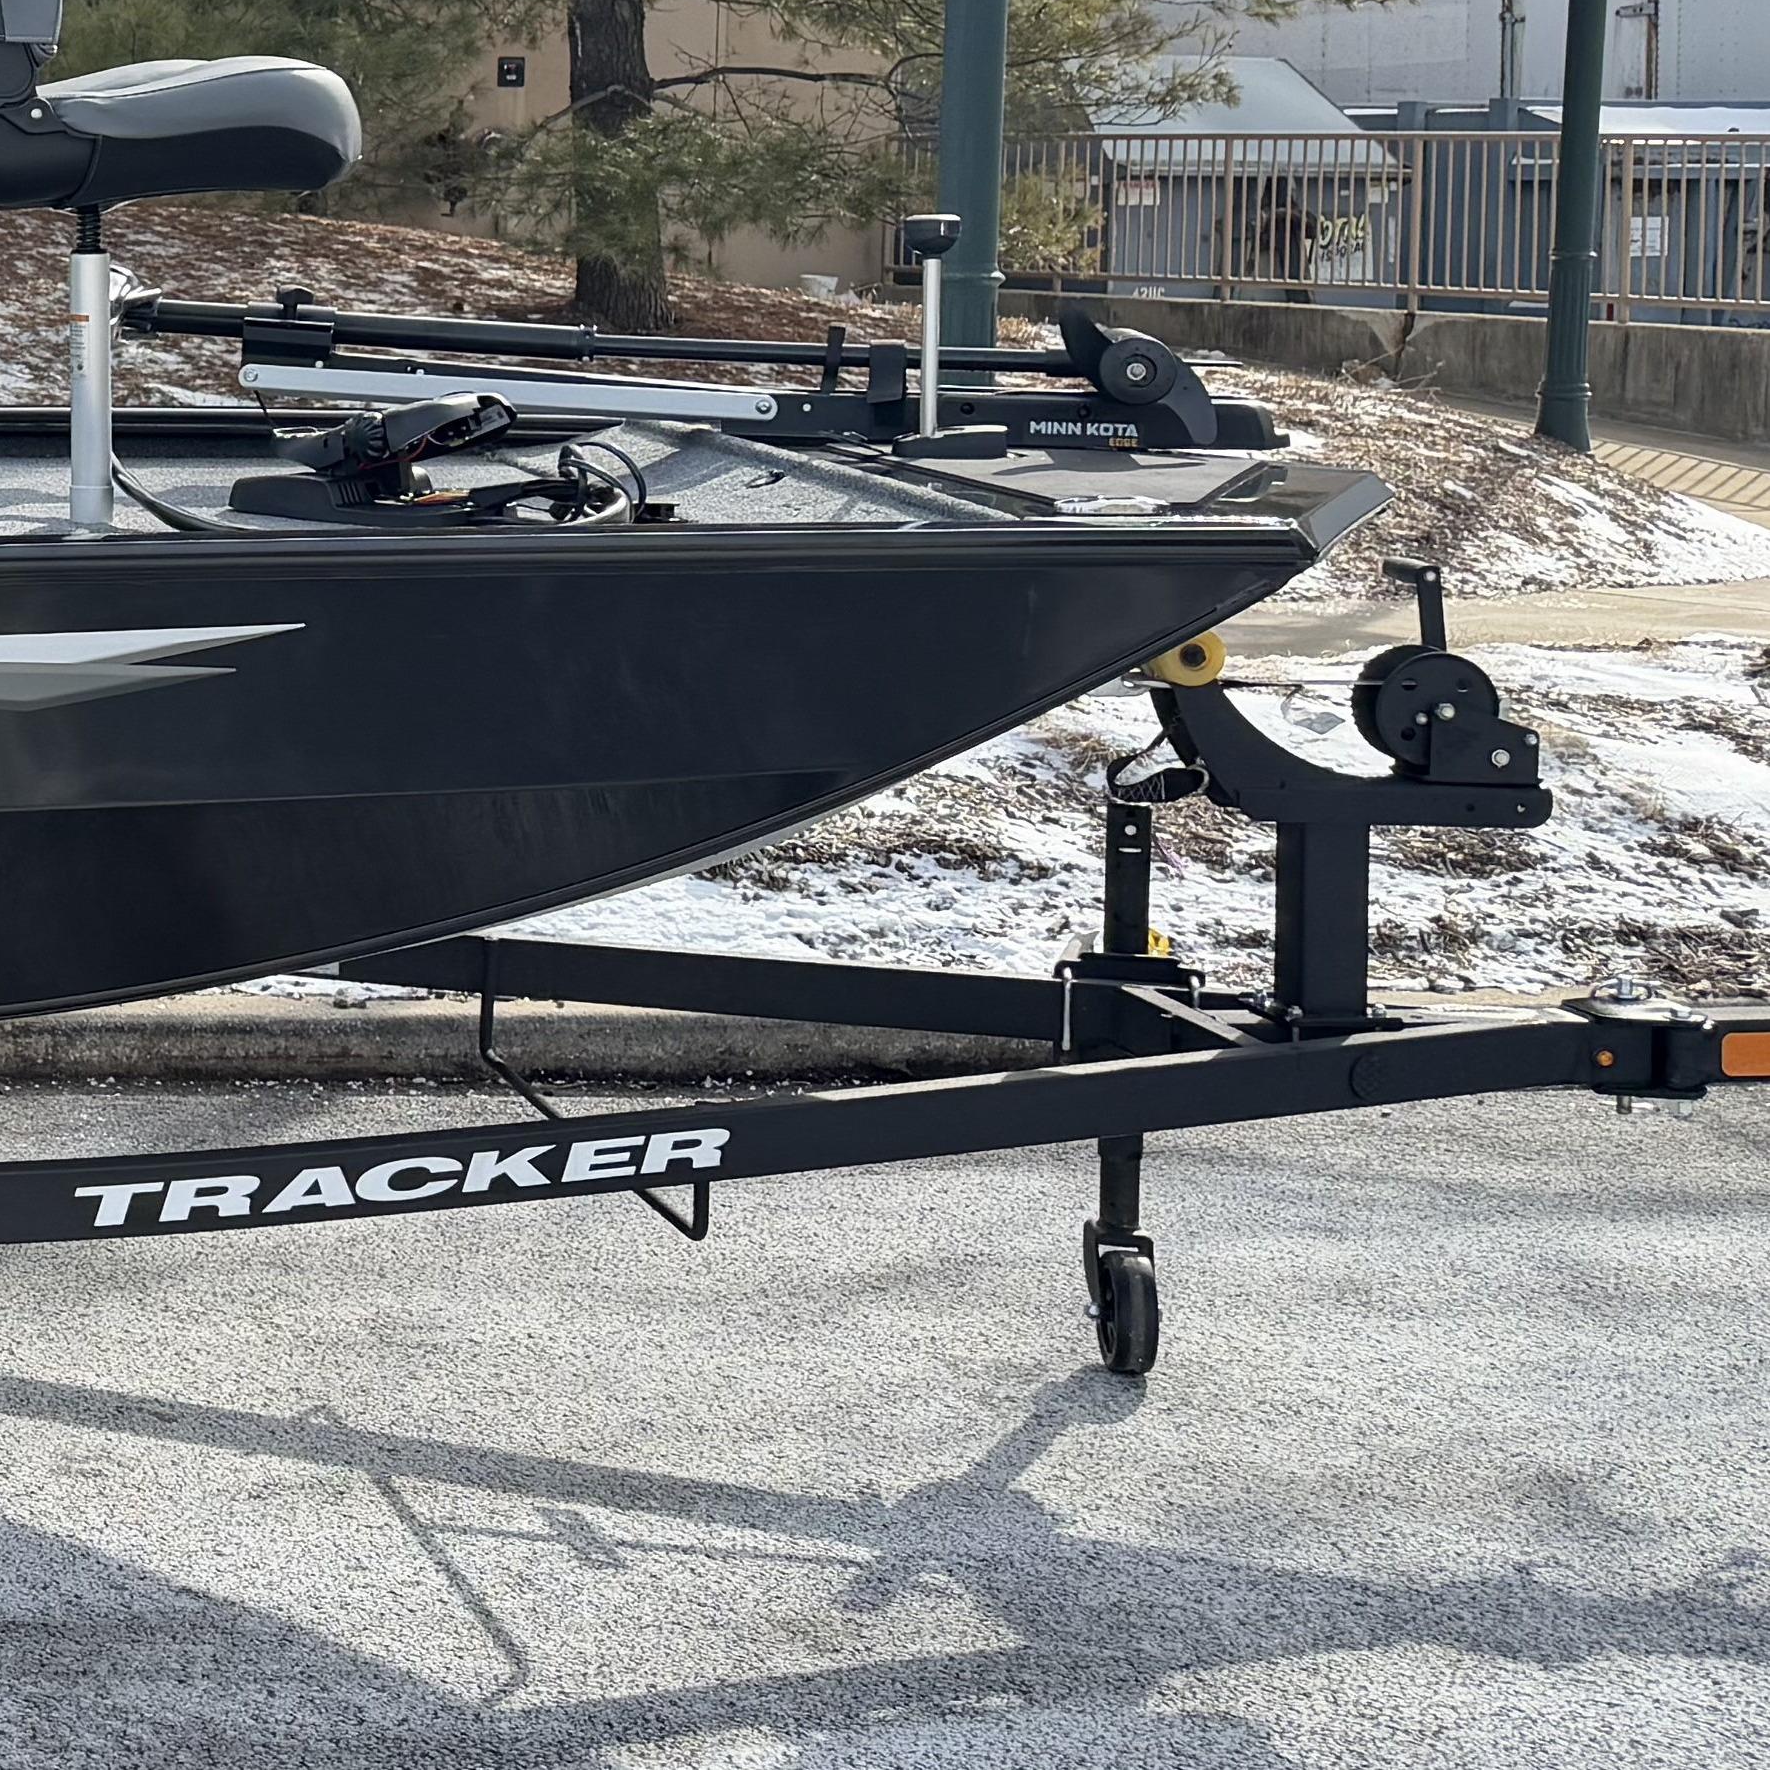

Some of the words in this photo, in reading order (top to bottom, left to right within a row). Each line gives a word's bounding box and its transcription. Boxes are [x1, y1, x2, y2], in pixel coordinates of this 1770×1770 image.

[1029, 420, 1082, 436] MINN
[1085, 422, 1139, 437] KOTA
[1108, 437, 1139, 448] EDGE
[74, 1127, 732, 1228] TRACKER
